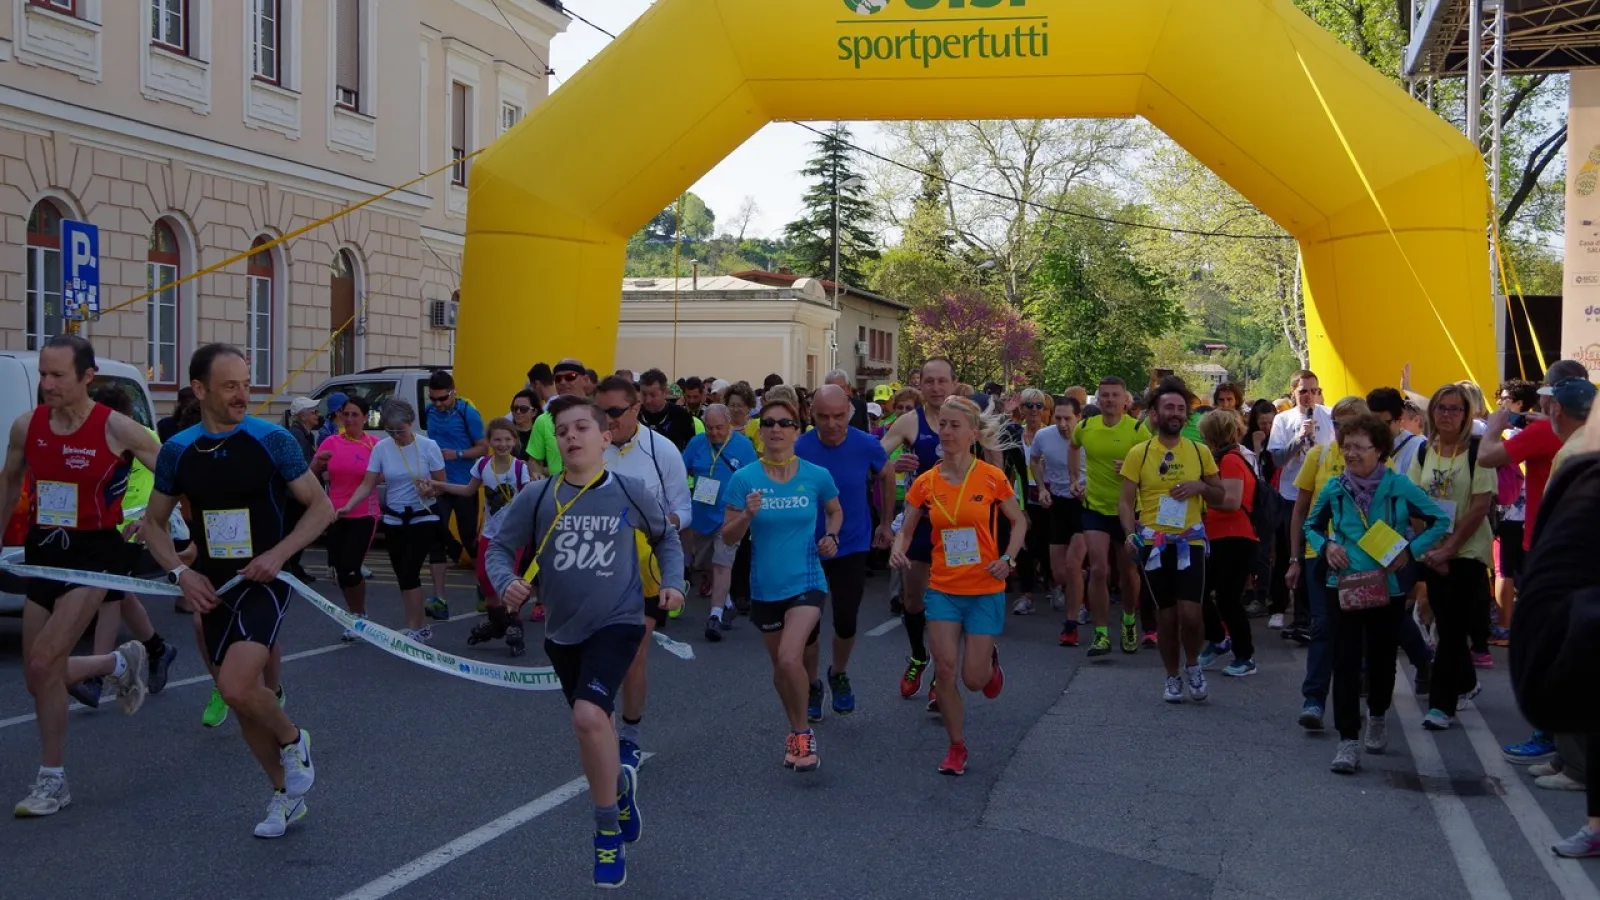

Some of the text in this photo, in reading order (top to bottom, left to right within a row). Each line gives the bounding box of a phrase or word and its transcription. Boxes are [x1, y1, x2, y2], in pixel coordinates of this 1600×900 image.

[837, 22, 1049, 69] sportpertutti
[71, 230, 91, 277] P
[555, 515, 621, 535] SEVENTY
[553, 530, 616, 571] Six
[471, 665, 501, 680] MARSH
